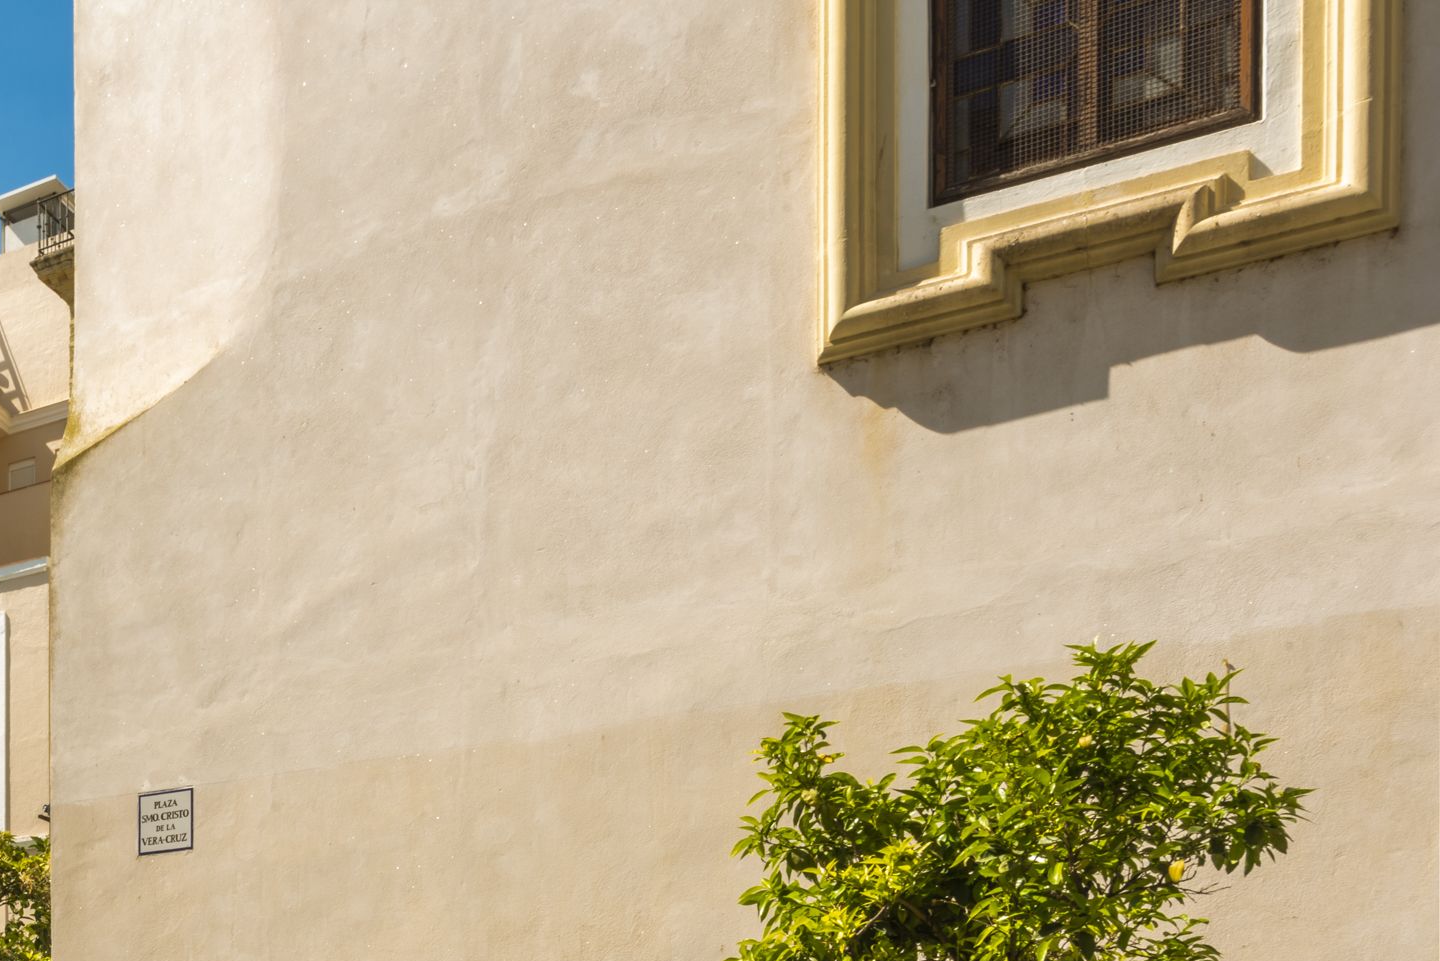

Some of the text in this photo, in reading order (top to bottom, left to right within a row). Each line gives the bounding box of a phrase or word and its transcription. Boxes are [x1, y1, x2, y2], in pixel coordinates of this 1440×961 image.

[154, 799, 178, 809] PLAZA
[141, 809, 190, 824] SMO. CRISTO
[166, 823, 176, 831] LA
[141, 833, 188, 846] VERA-CRUZ
